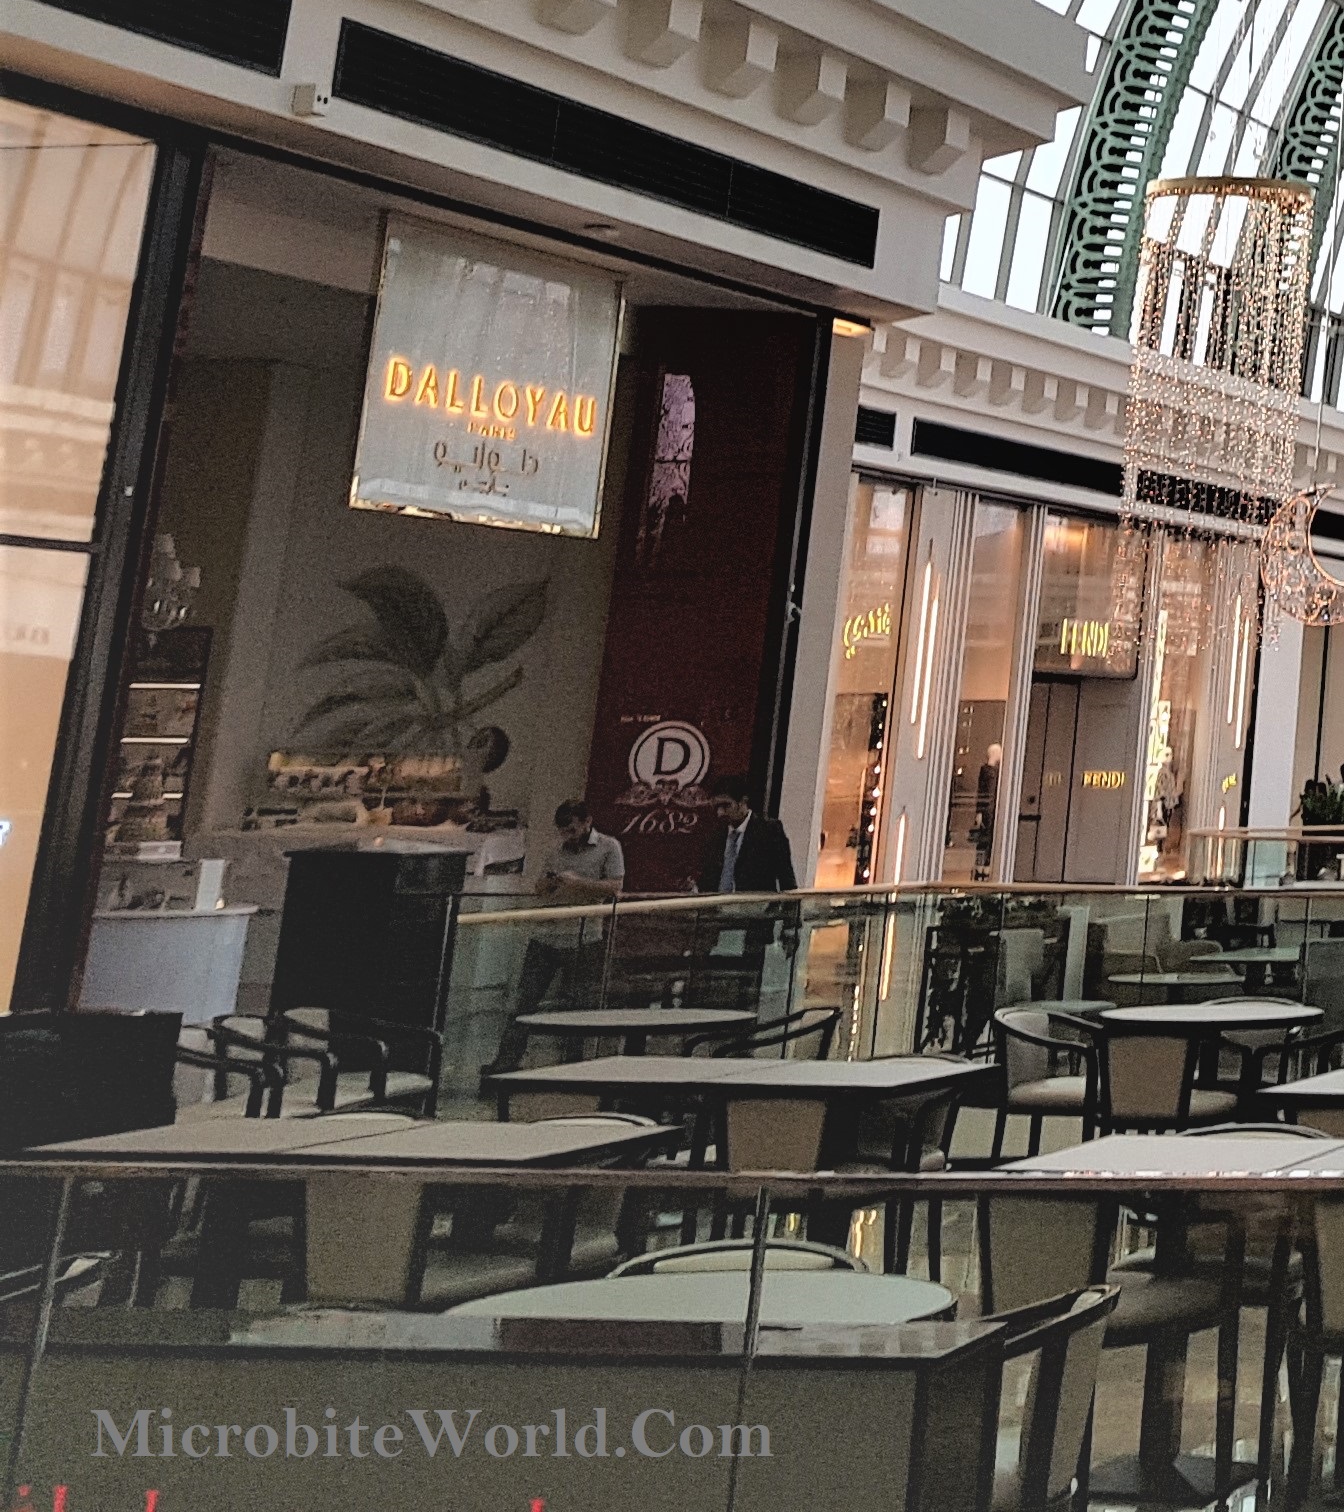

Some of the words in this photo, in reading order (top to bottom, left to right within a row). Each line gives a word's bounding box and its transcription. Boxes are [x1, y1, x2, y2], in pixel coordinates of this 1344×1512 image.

[384, 357, 597, 437] DALLOYAU
[1060, 617, 1110, 658] FENDI
[652, 737, 691, 776] D
[1081, 769, 1125, 790] FENDI
